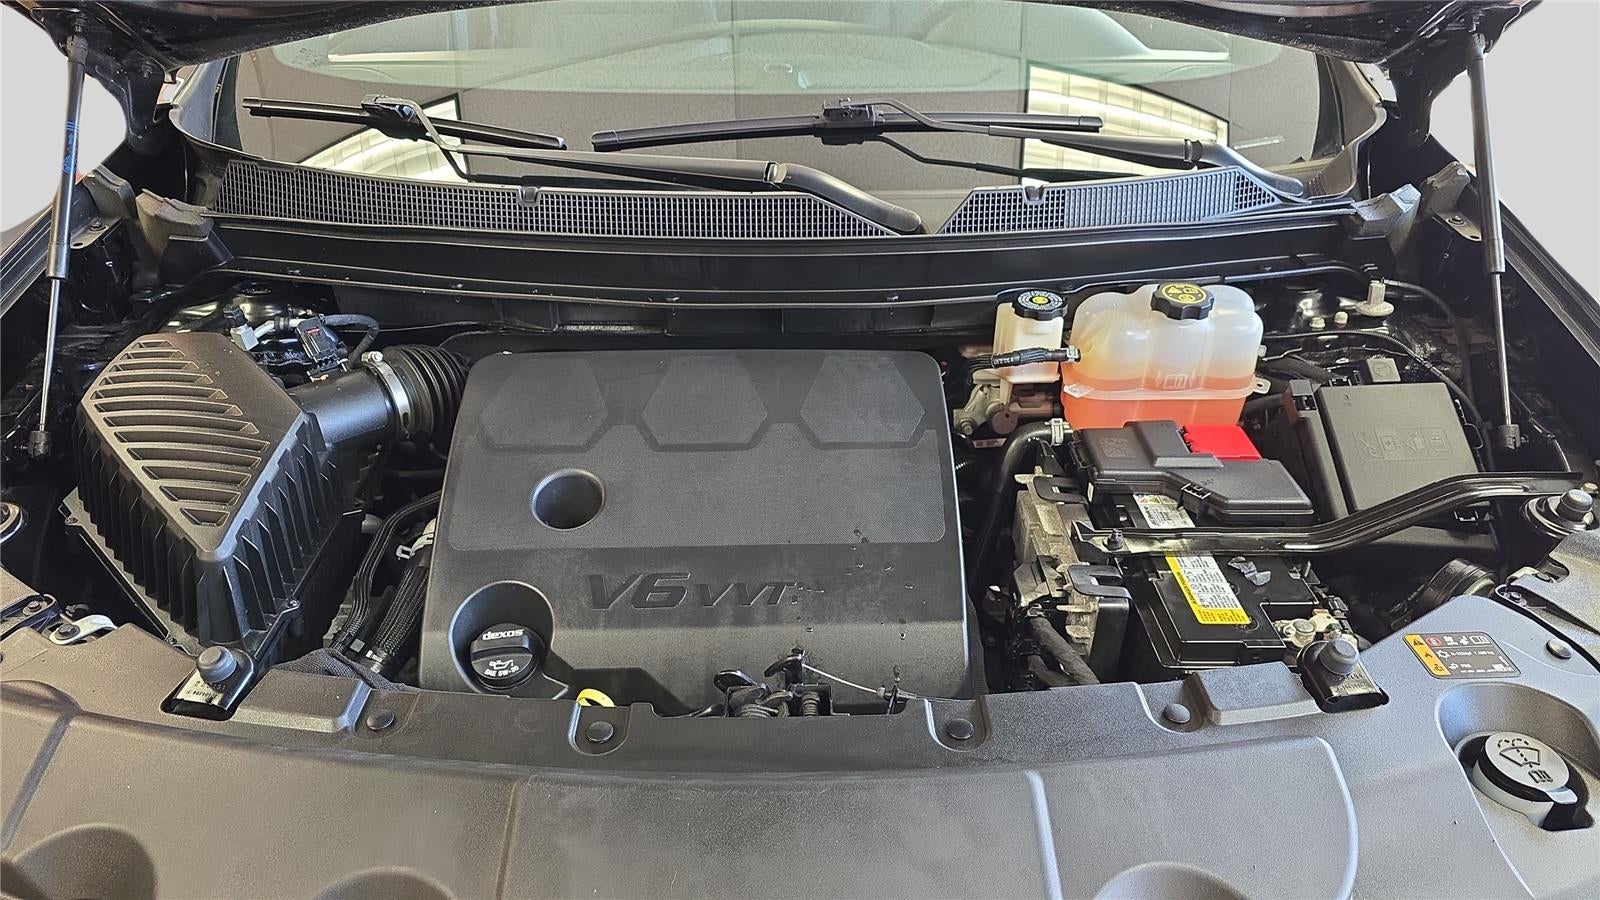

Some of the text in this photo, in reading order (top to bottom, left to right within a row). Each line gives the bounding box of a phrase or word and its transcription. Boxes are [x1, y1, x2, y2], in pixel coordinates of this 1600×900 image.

[589, 572, 799, 610] V6 VVT
[482, 628, 524, 640] dexos
